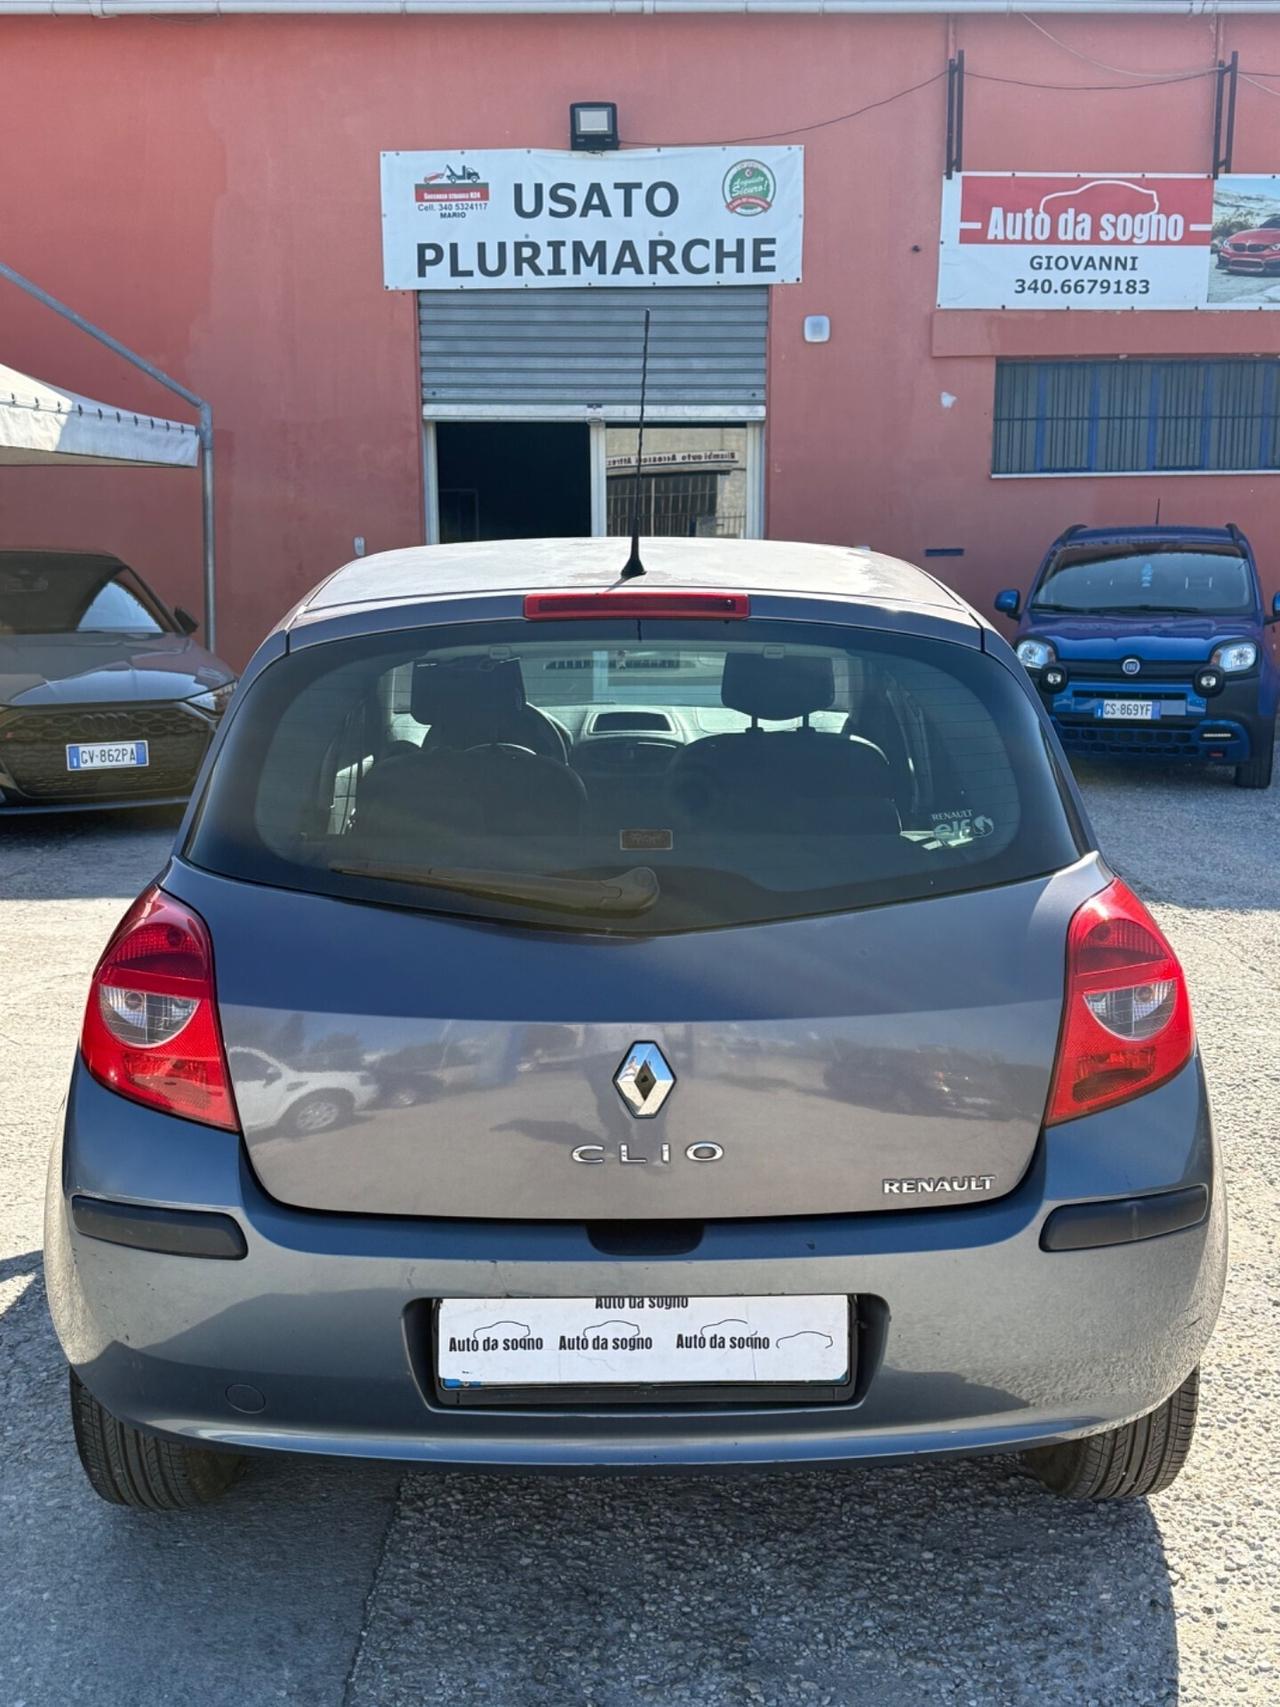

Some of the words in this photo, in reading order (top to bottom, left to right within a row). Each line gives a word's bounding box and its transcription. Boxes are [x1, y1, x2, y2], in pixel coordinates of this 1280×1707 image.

[417, 204, 436, 212] Cell.
[439, 203, 453, 211] 340
[455, 202, 488, 211] 5324117
[513, 181, 679, 219] USATO
[440, 211, 466, 219] MARIO
[987, 206, 1051, 241] Auto
[1057, 207, 1092, 241] da
[1099, 213, 1185, 244] sogno
[416, 237, 777, 277] PLURIMARCHE
[1029, 255, 1139, 271] GIOVANNI
[1014, 279, 1150, 295] 340.6679183
[931, 809, 974, 821] RENAULT
[571, 1142, 724, 1165] CLIO
[882, 1175, 997, 1195] RENAULT
[449, 1337, 479, 1352] Auto
[482, 1337, 499, 1351] da
[559, 1335, 588, 1351] Auto
[592, 1335, 609, 1350] da
[612, 1336, 653, 1351] sogno
[676, 1334, 706, 1349] Auto
[709, 1334, 726, 1349] da
